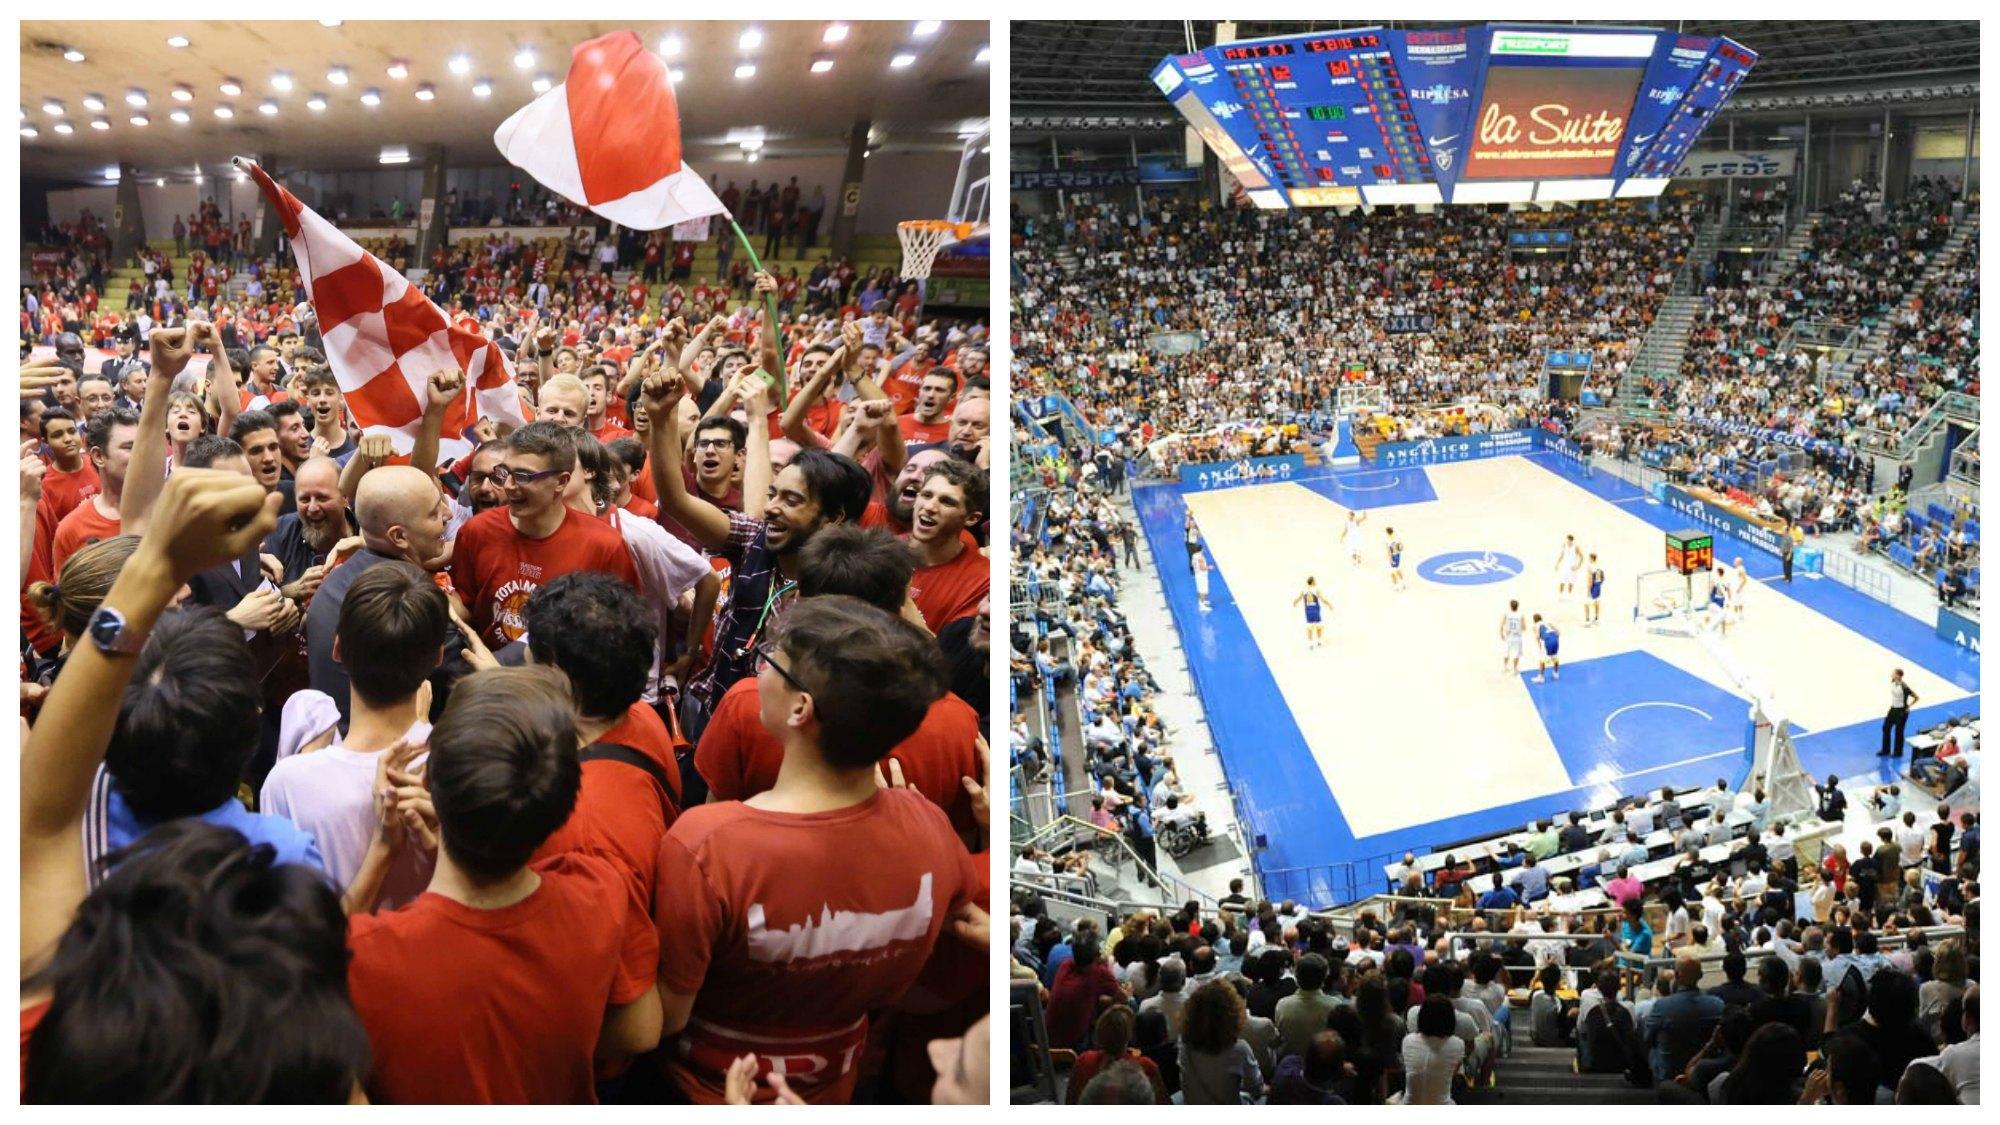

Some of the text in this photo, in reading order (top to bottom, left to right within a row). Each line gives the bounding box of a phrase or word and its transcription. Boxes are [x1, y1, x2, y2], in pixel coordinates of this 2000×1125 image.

[1411, 88, 1469, 99] RIPRESA
[1480, 102, 1624, 145] la Suite
[1701, 161, 1781, 176] FEDE
[1386, 443, 1469, 459] ANGELICO
[1671, 498, 1731, 532] ANGELICO
[1750, 533, 1784, 557] PASSION
[1686, 547, 1711, 570] 24
